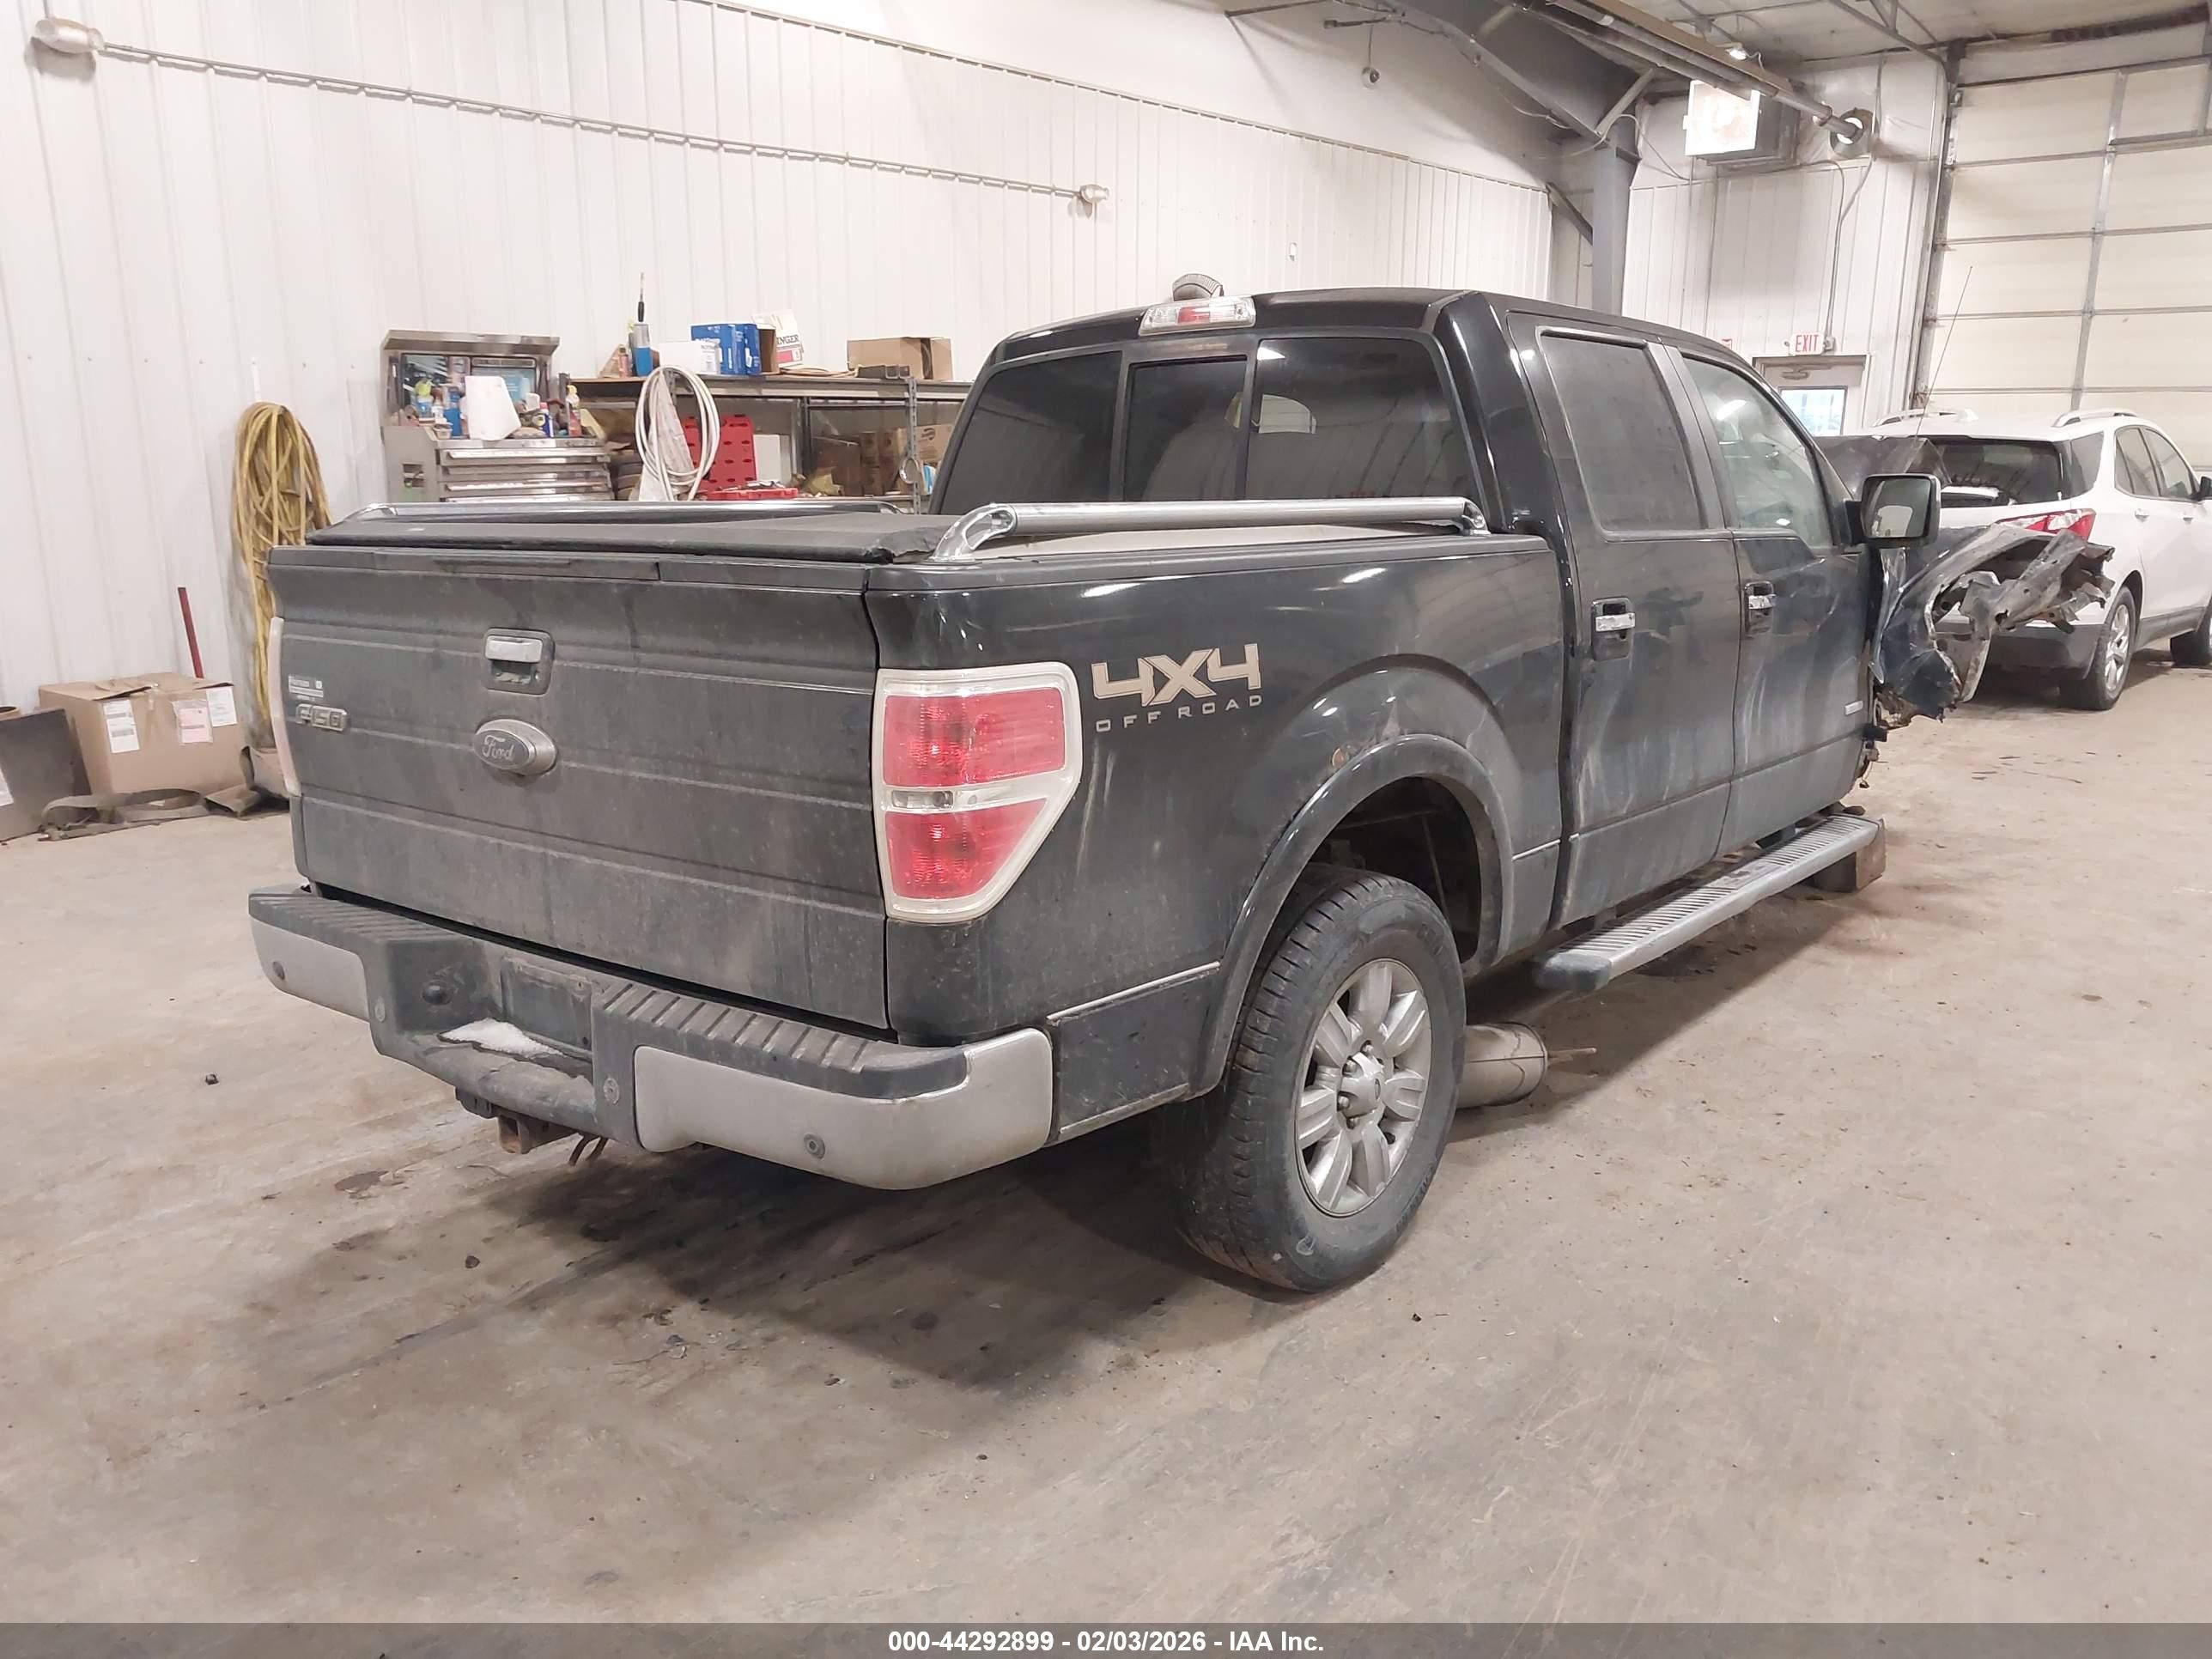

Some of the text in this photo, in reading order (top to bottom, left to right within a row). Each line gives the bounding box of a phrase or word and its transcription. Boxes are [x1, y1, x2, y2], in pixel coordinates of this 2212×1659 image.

[1795, 334, 1820, 353] EXIT
[1091, 643, 1262, 707] 4X4
[1095, 694, 1263, 732] OFF ROAD
[482, 734, 514, 762] Ford
